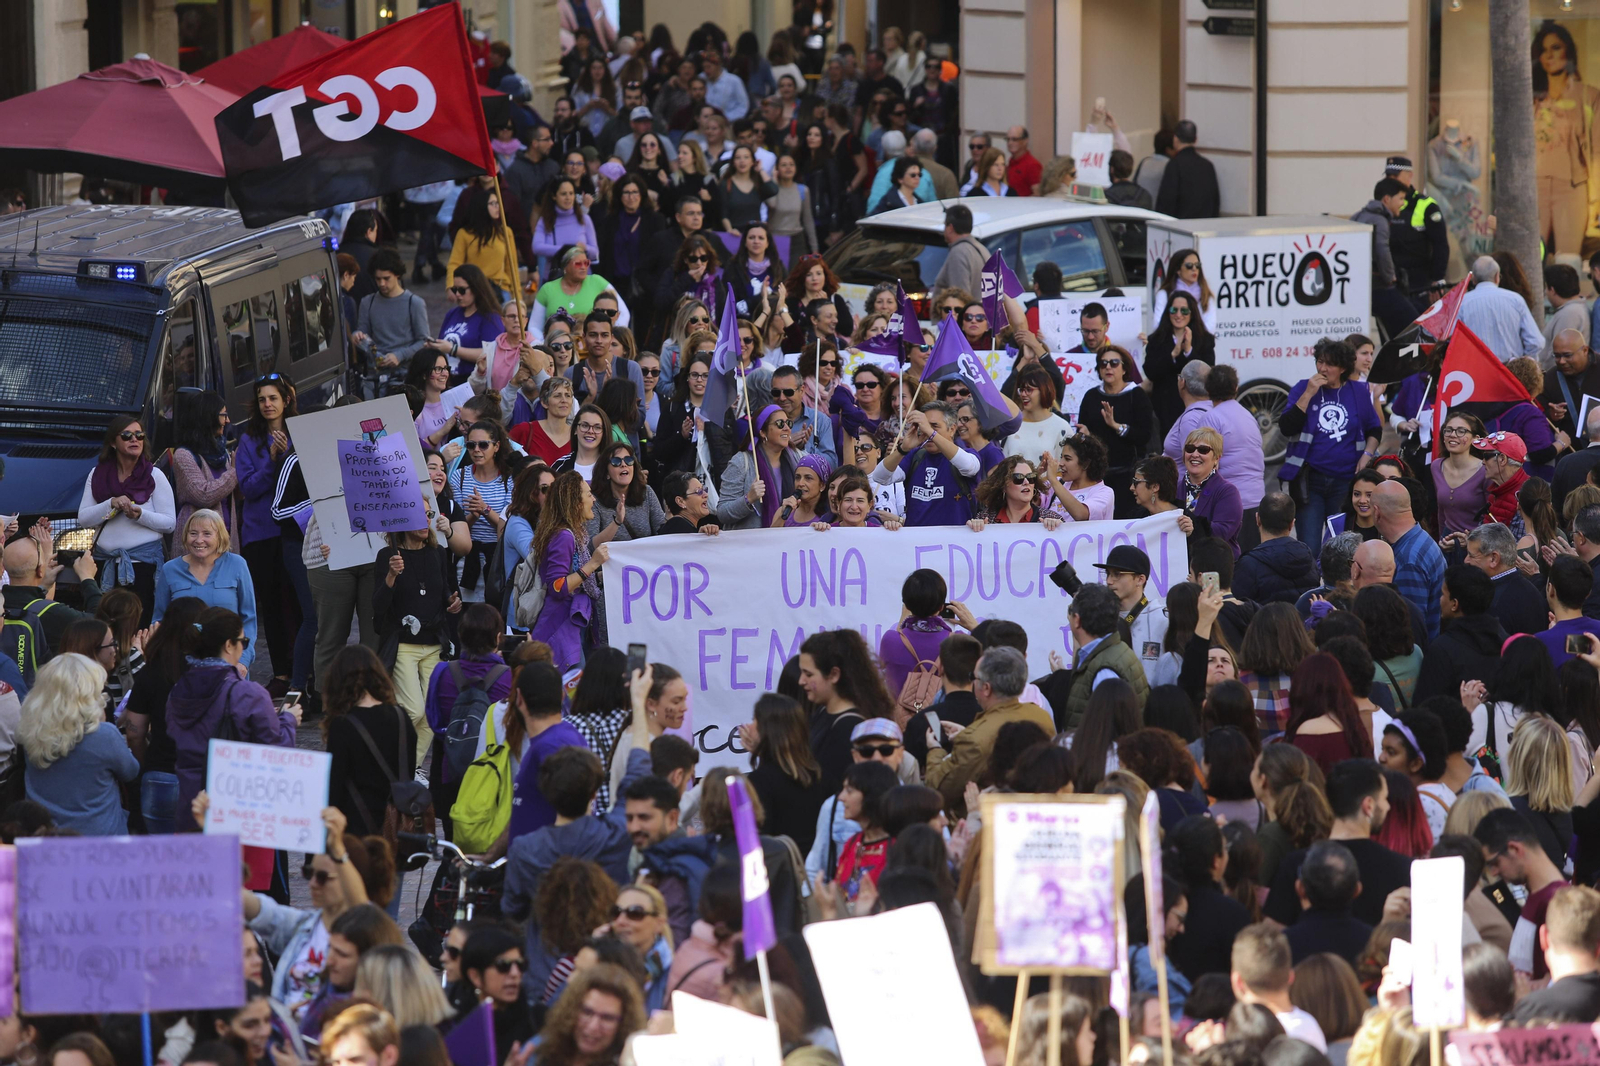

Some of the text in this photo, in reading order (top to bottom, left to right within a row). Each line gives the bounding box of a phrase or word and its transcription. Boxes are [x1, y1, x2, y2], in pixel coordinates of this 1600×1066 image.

[1240, 319, 1276, 328] FRESCO
[1292, 316, 1362, 326] HUEVO COCIDO
[1230, 348, 1254, 359] TLF.
[1262, 347, 1283, 358] 608
[1286, 346, 1299, 358] 24
[345, 450, 407, 466] PROFESORA
[351, 466, 407, 477] LUCHANDO
[622, 561, 713, 625] POR
[781, 546, 868, 610] UNA
[215, 745, 232, 759] NO
[215, 772, 305, 807] COLABORA
[241, 821, 276, 841] SER
